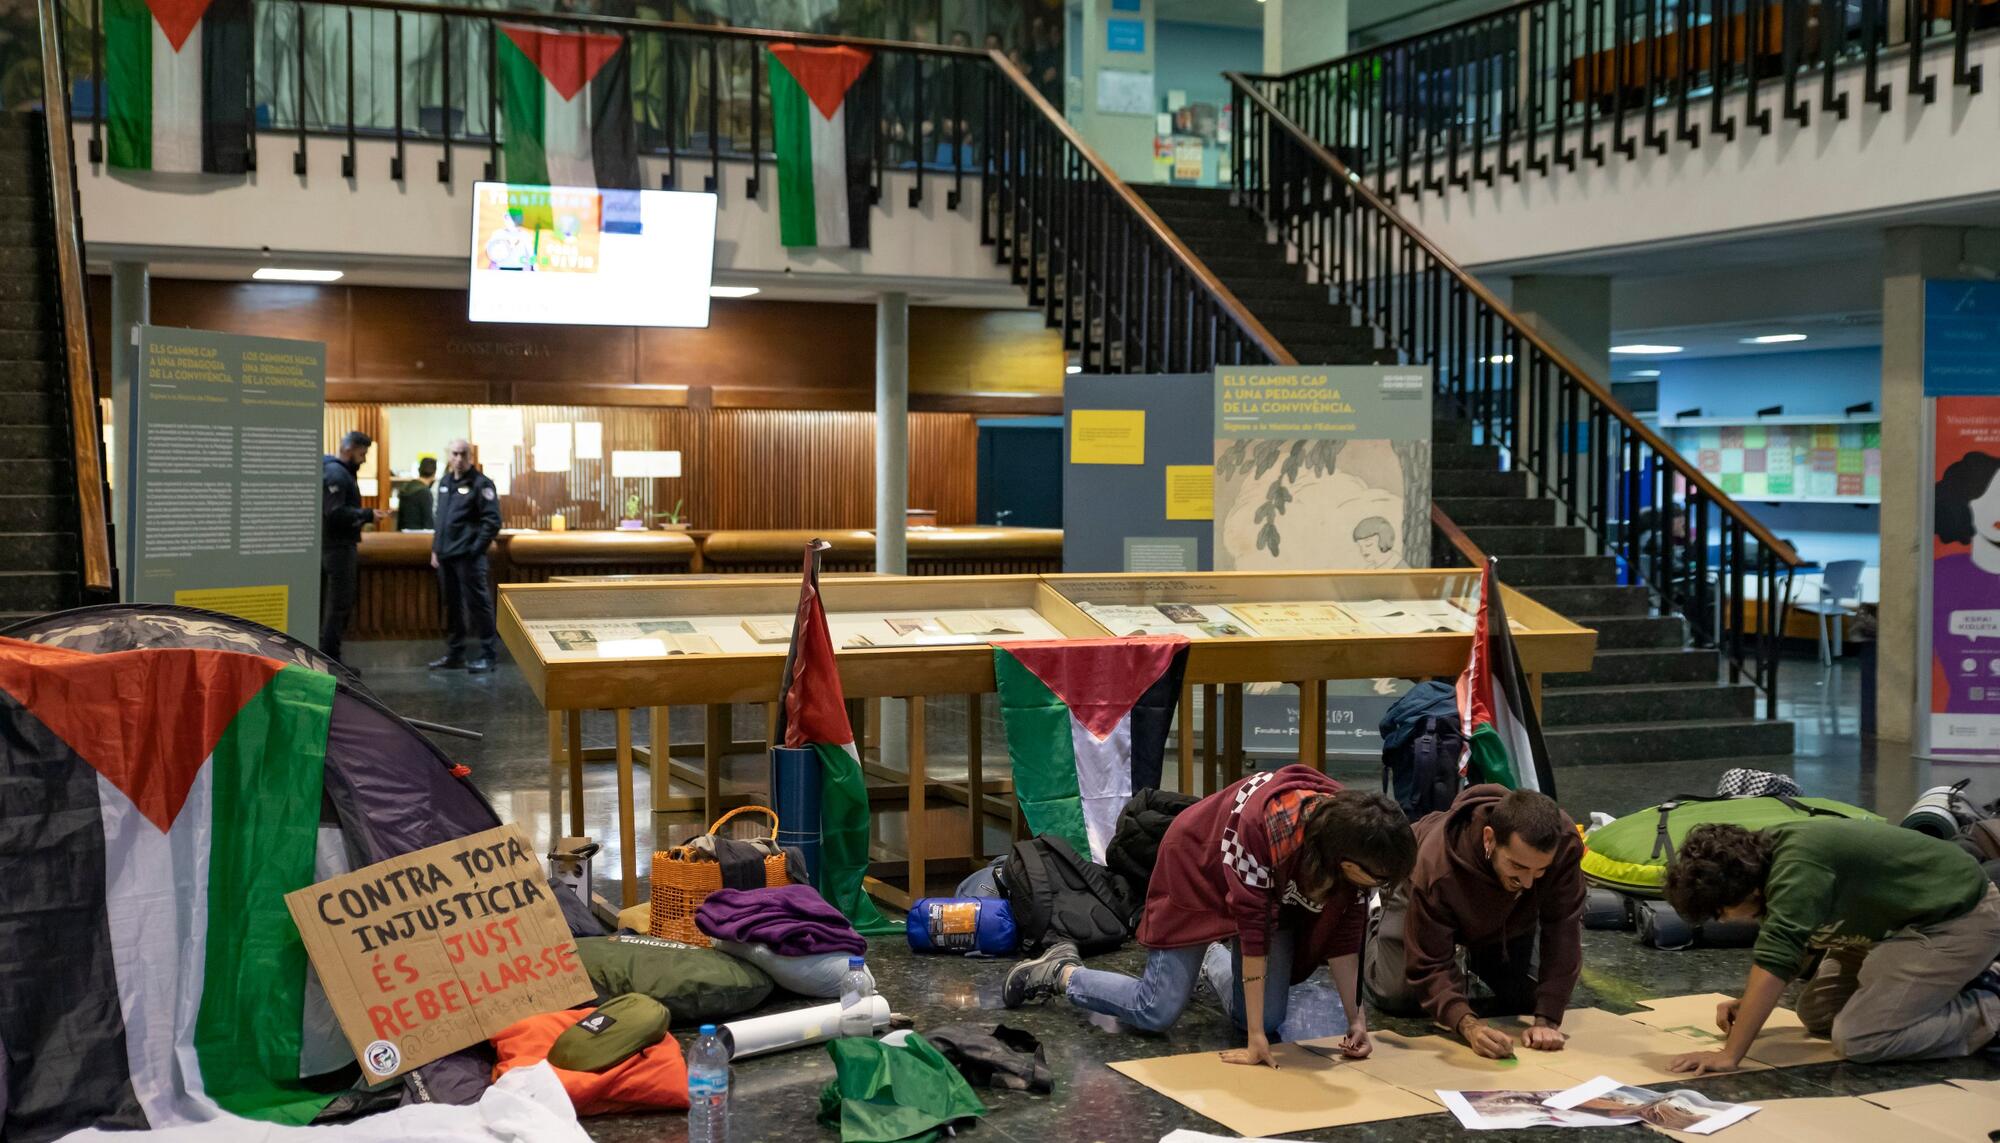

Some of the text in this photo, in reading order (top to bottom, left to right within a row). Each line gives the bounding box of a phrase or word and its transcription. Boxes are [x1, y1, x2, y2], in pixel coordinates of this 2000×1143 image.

[149, 344, 218, 358] ELS CAMINS CAP
[242, 351, 259, 361] LOS
[158, 359, 175, 368] UNA
[149, 368, 161, 379] DE
[162, 370, 173, 380] LA
[1223, 375, 1328, 387] ELS CAMINS CAP
[1223, 389, 1341, 400] A UNA PEDAGOGIA
[1223, 402, 1239, 413] DE
[1242, 402, 1259, 413] LA
[317, 836, 530, 926] CONTRA TOTA
[352, 878, 546, 954] INJUSTÍCIA
[371, 916, 521, 994] ÉS JUST
